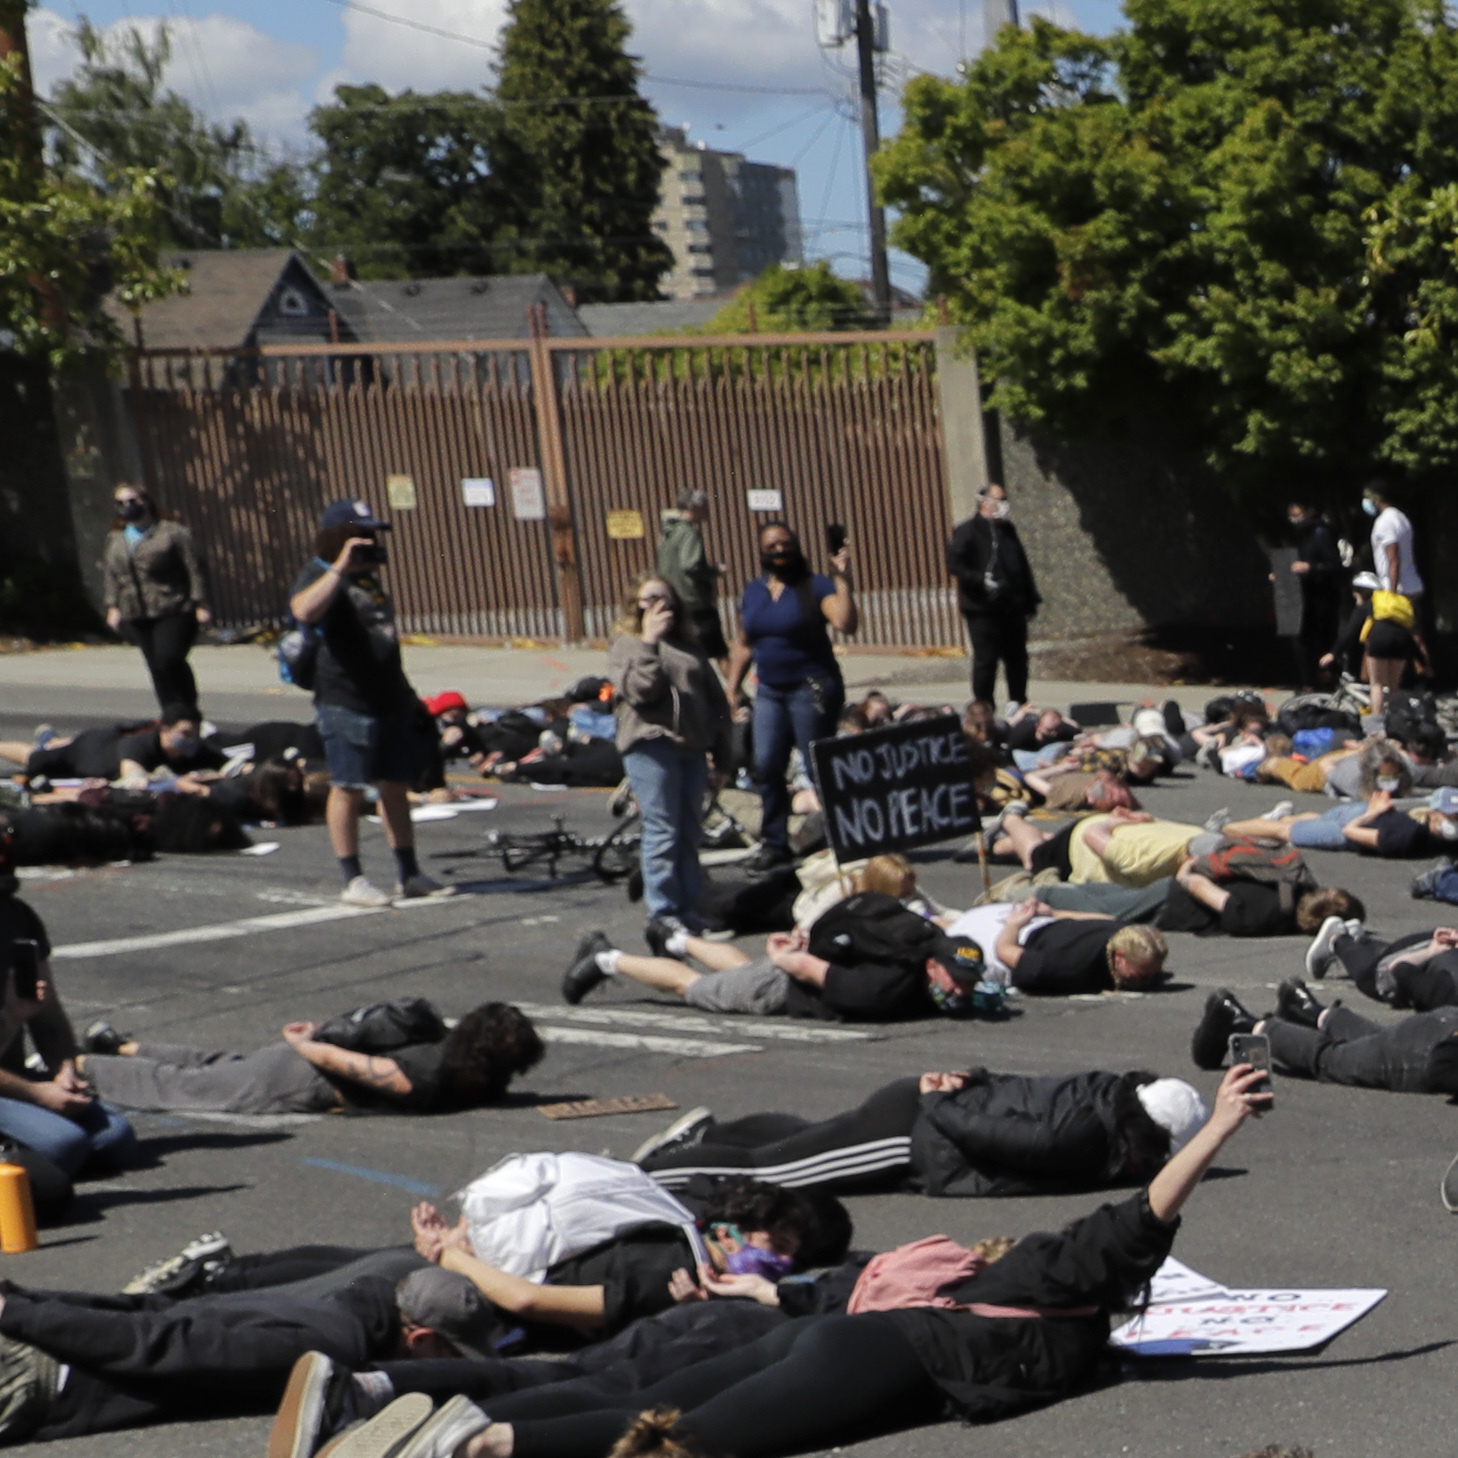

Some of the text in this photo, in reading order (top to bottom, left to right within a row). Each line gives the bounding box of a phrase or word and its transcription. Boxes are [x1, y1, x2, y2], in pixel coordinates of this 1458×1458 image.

[831, 731, 970, 791] NO JUSTICE
[834, 783, 973, 848] NO PEACE
[1201, 1315, 1278, 1325] NO
